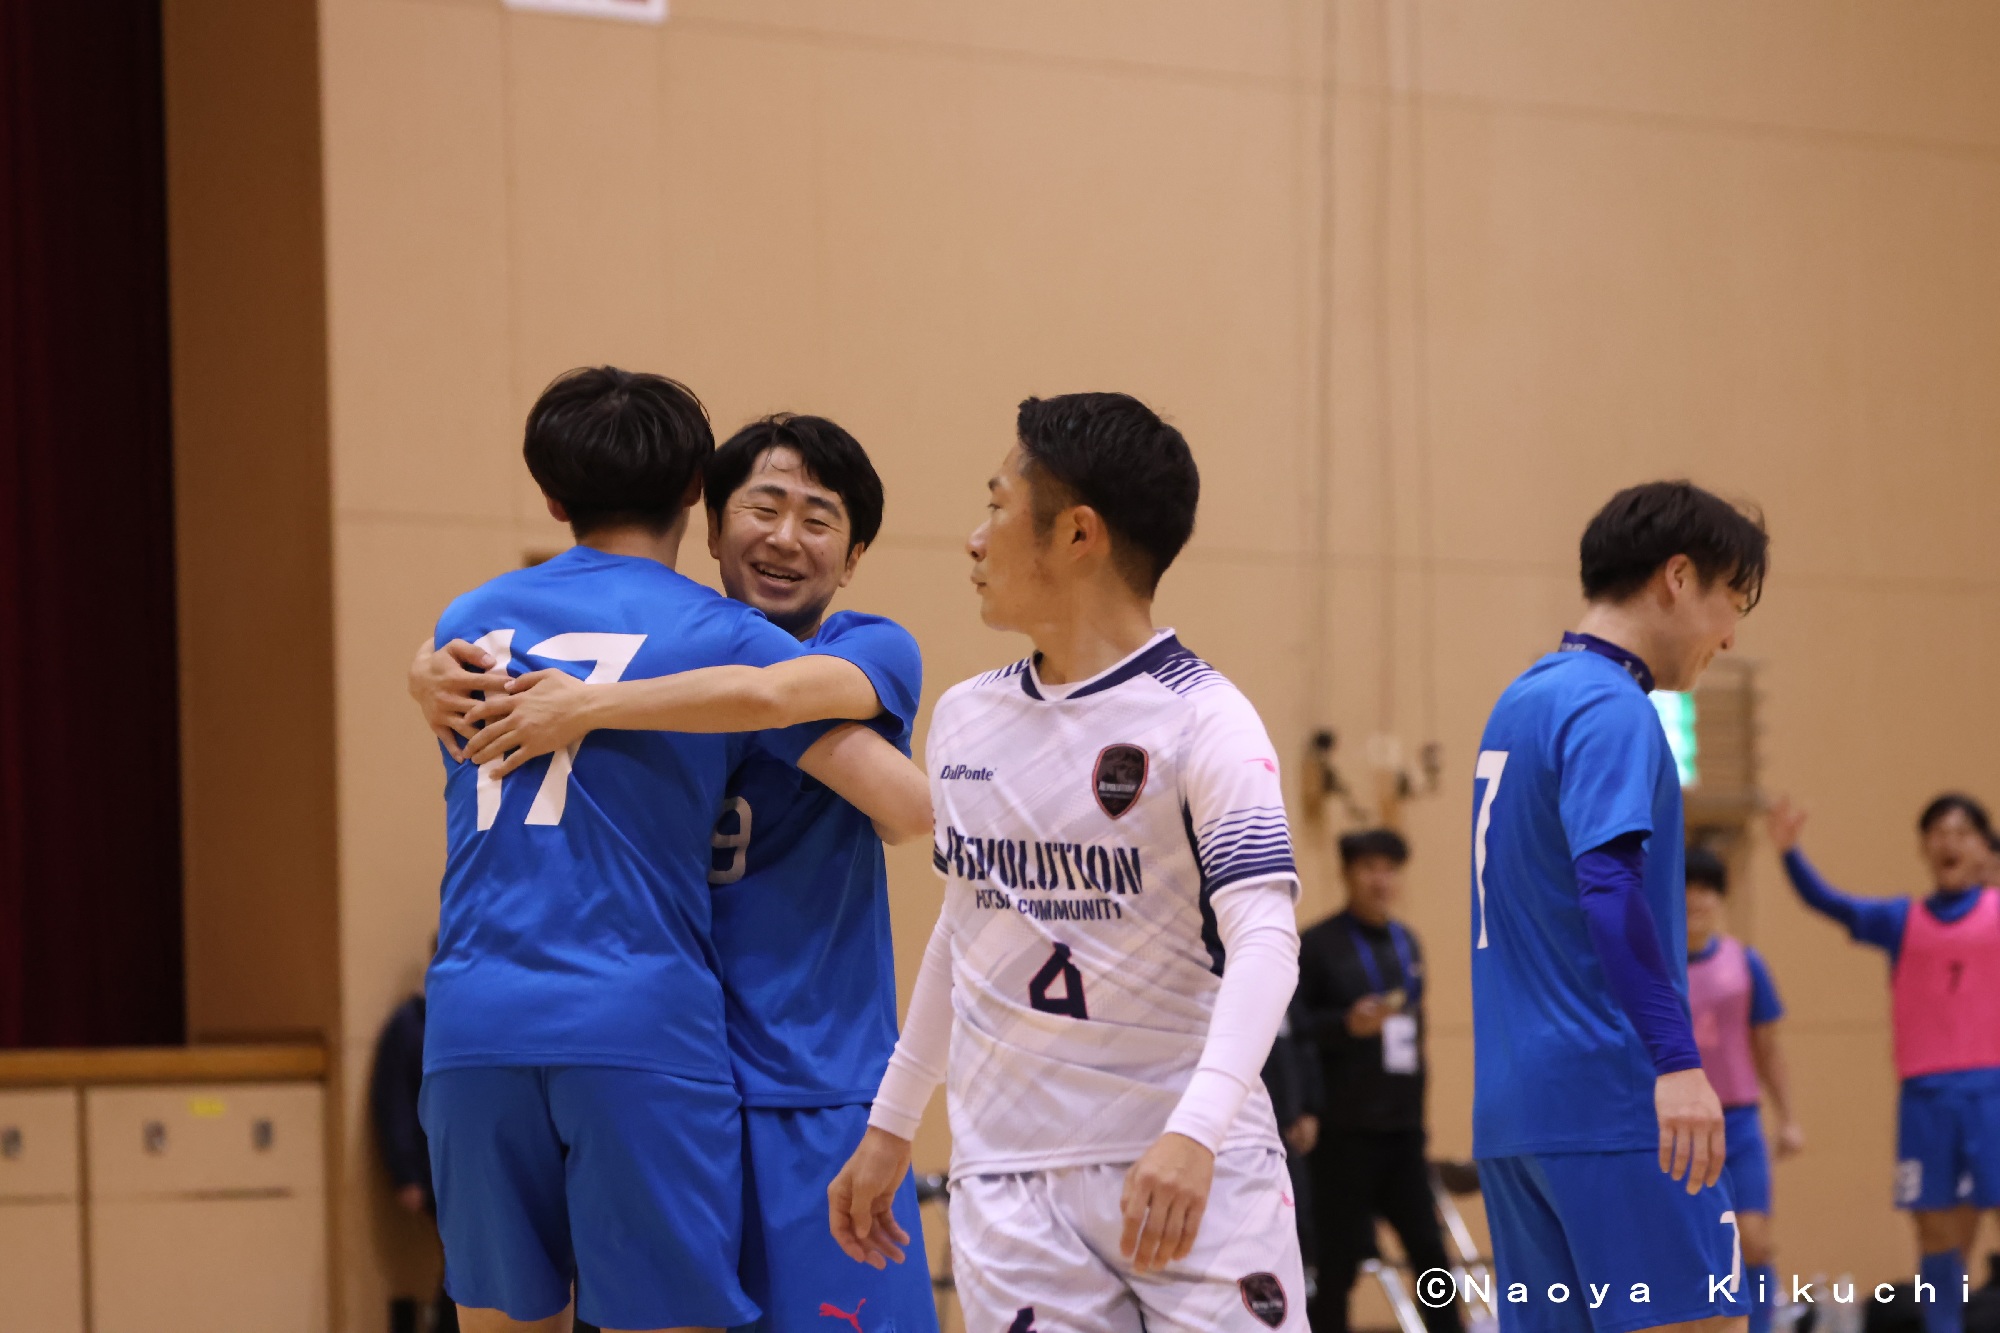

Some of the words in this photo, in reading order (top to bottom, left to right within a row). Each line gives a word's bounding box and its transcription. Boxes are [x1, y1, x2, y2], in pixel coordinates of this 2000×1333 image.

[473, 629, 648, 831] 17
[940, 764, 994, 781] DalPonte
[947, 826, 1143, 894] REVOLUTION
[1475, 750, 1508, 949] 7
[1017, 898, 1123, 921] COMMUNITY
[1029, 941, 1089, 1019] 4
